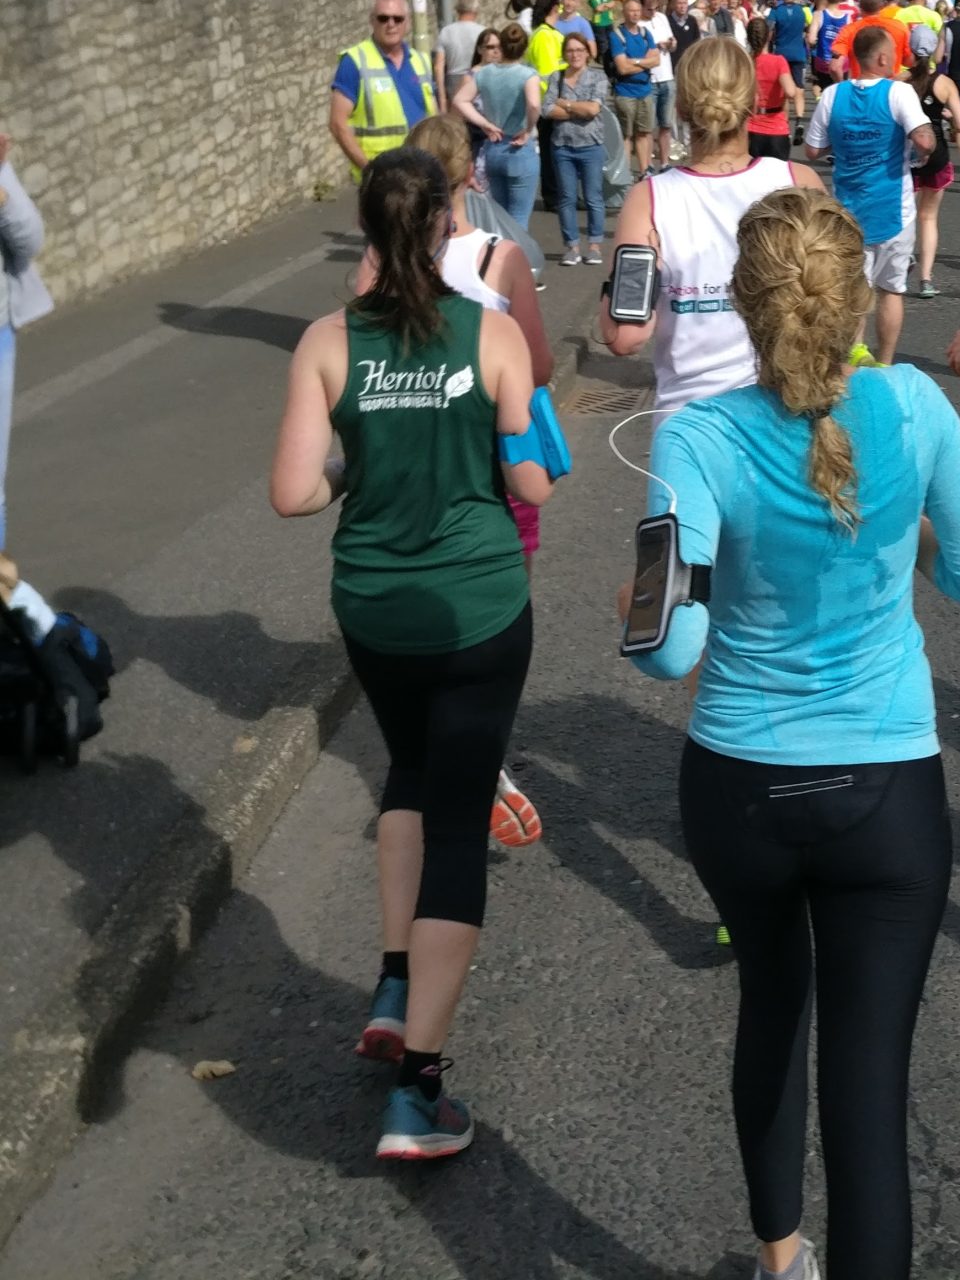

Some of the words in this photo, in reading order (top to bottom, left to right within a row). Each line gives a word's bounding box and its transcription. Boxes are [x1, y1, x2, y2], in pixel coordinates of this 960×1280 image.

[703, 283, 721, 294] for
[355, 359, 447, 397] Herriot
[358, 397, 398, 412] HOSPICE
